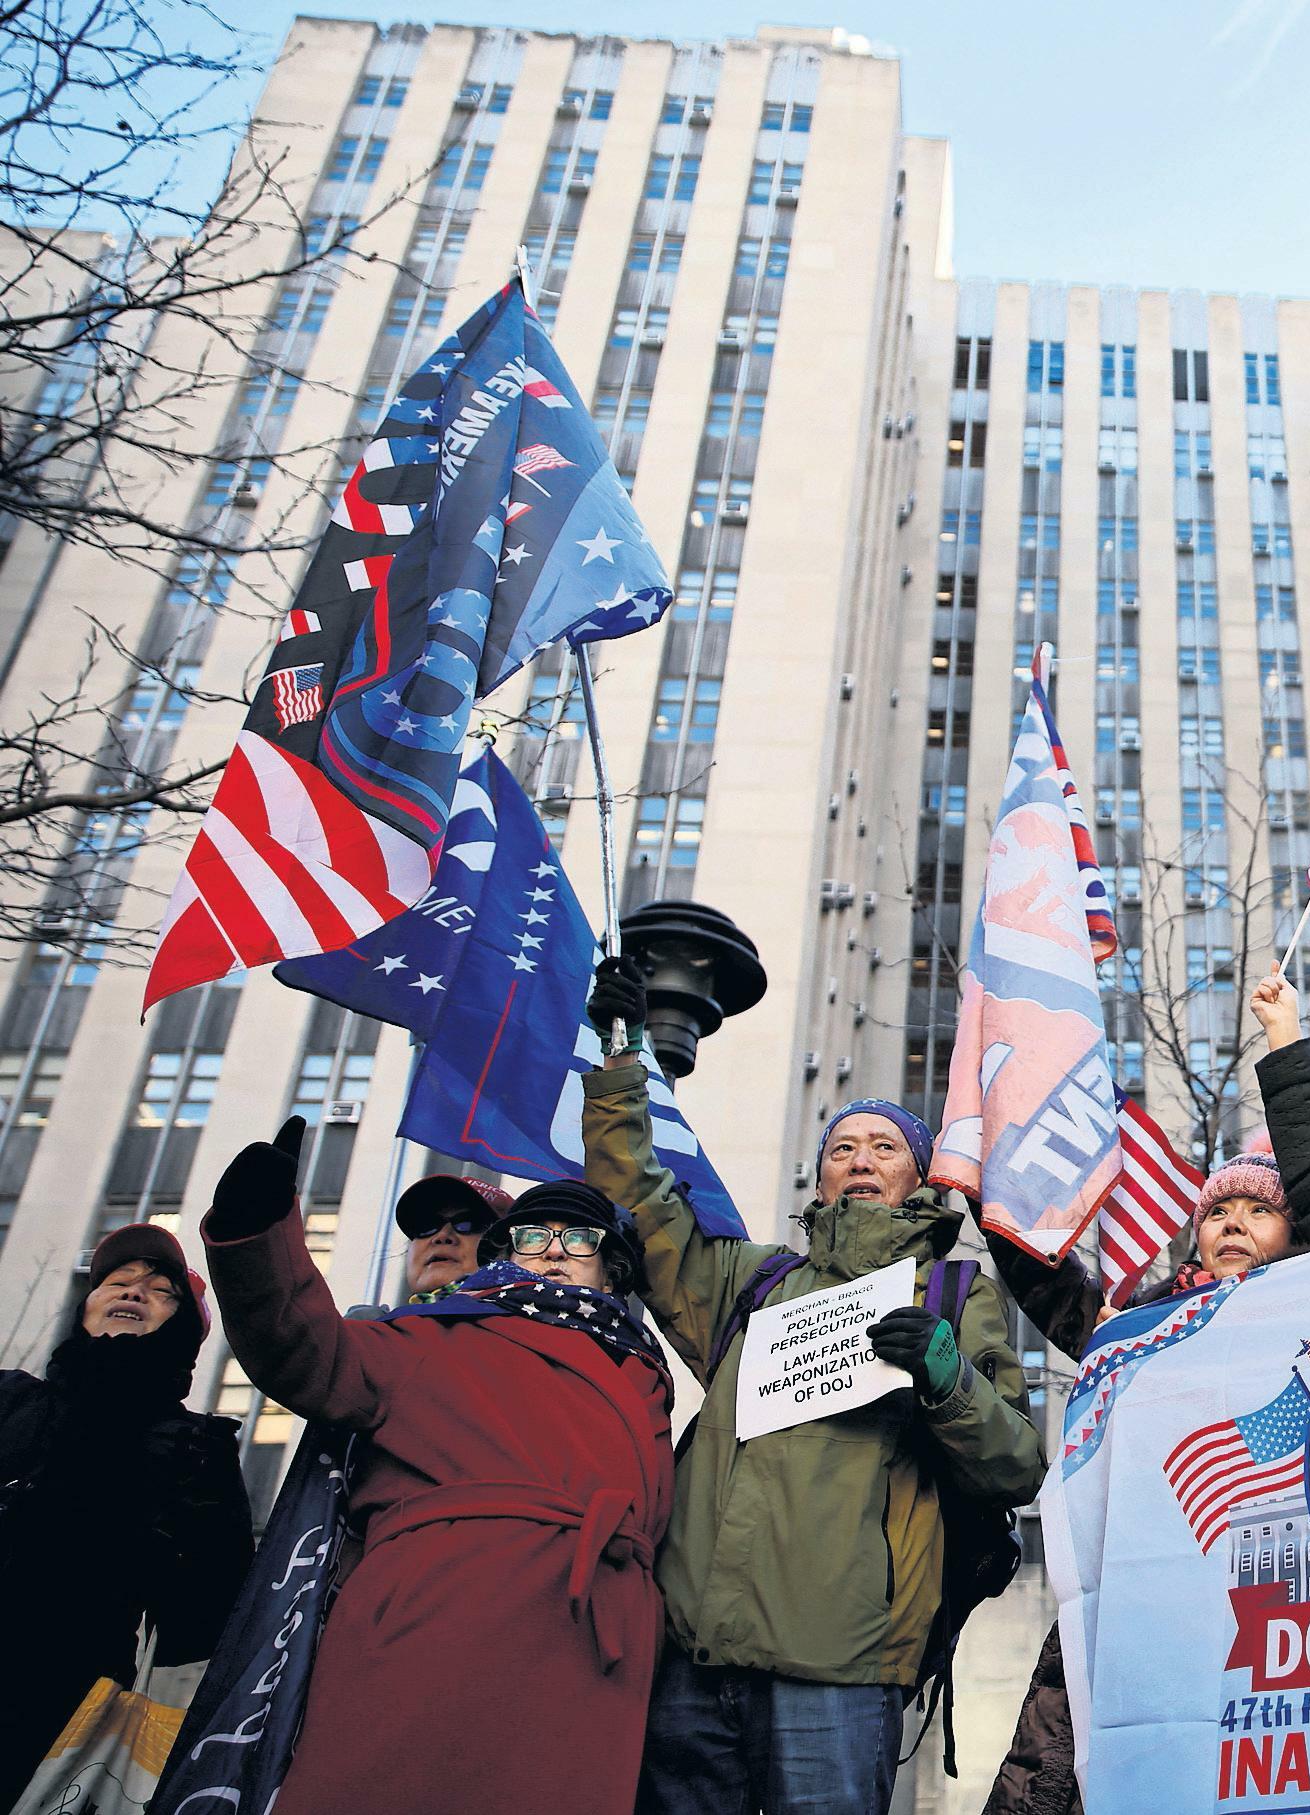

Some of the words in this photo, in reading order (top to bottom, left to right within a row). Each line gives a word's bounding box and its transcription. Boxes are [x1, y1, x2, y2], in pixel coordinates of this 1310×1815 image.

[781, 1298, 830, 1320] MERCHAN
[837, 1284, 874, 1301] BRAGG
[787, 1300, 863, 1334] POLITICAL
[770, 1308, 877, 1355] PERSECUTION
[783, 1334, 860, 1372] LAW-FARE
[758, 1347, 877, 1398] WEAPONIZATIO
[794, 1386, 815, 1403] OF
[820, 1374, 853, 1396] DOJ
[1219, 1694, 1293, 1733] 47th
